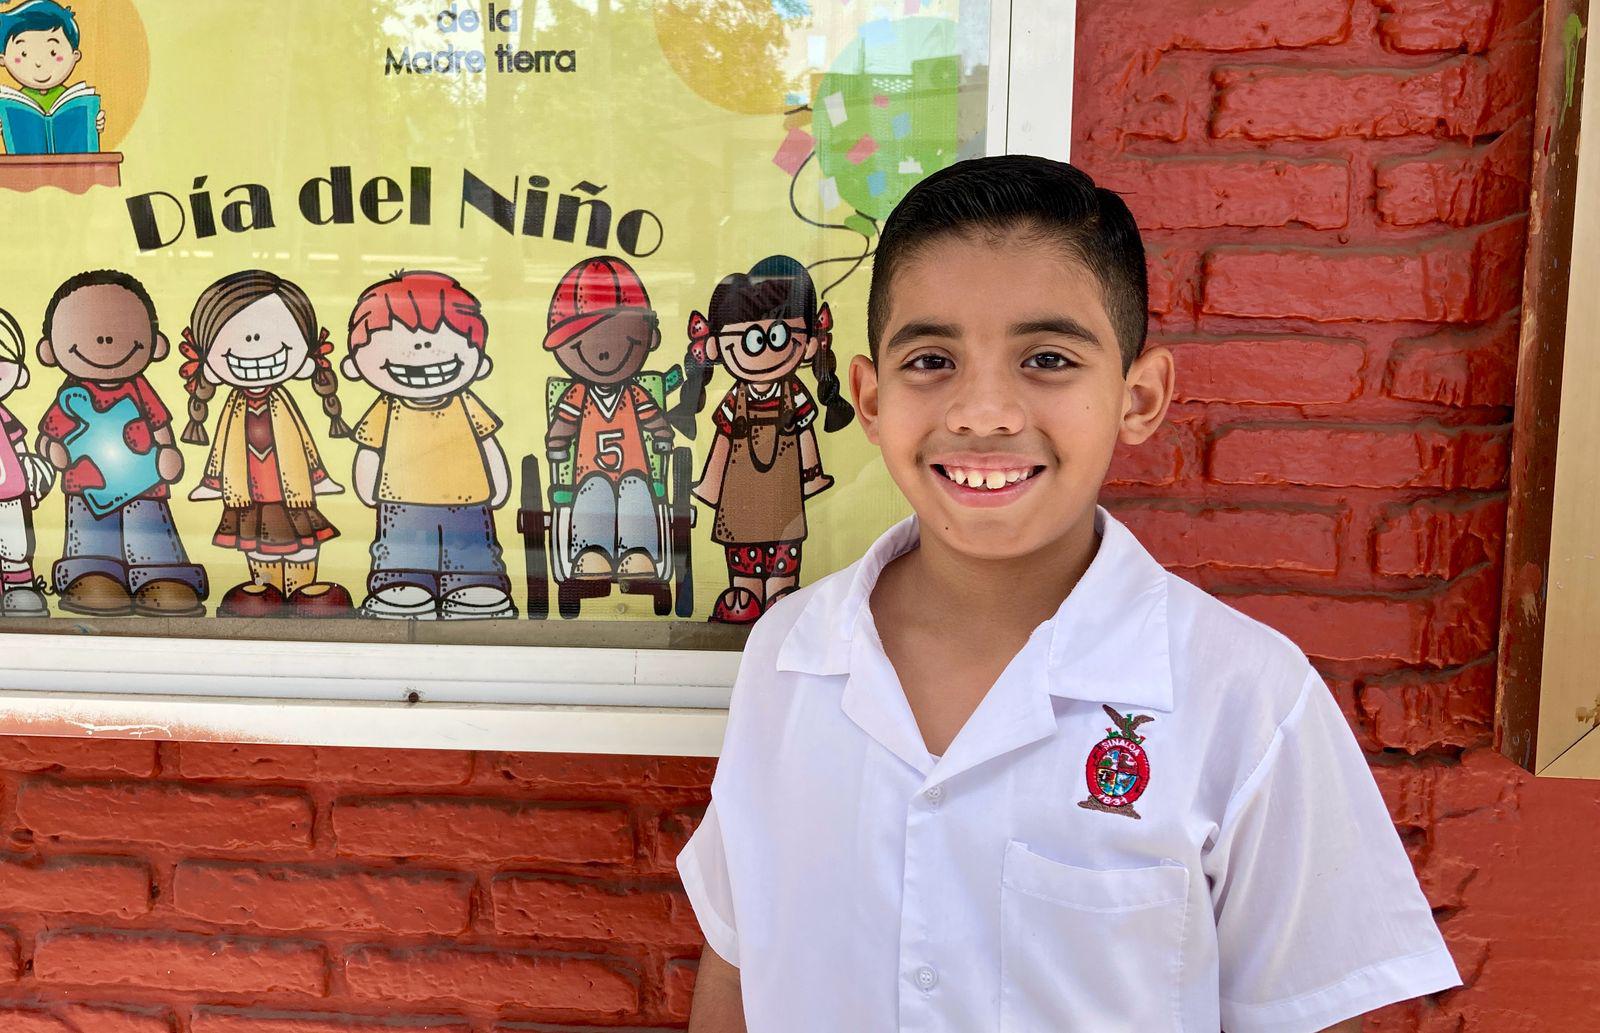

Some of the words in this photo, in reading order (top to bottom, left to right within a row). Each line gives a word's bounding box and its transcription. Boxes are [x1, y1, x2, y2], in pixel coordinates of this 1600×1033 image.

[436, 2, 480, 33] de
[488, 2, 517, 32] la
[385, 43, 486, 76] Madre
[495, 43, 577, 73] tierra
[126, 175, 276, 252] Día
[298, 165, 432, 226] del
[461, 168, 664, 258] Niño
[593, 428, 625, 472] 5
[1101, 738, 1141, 757] SINALOA
